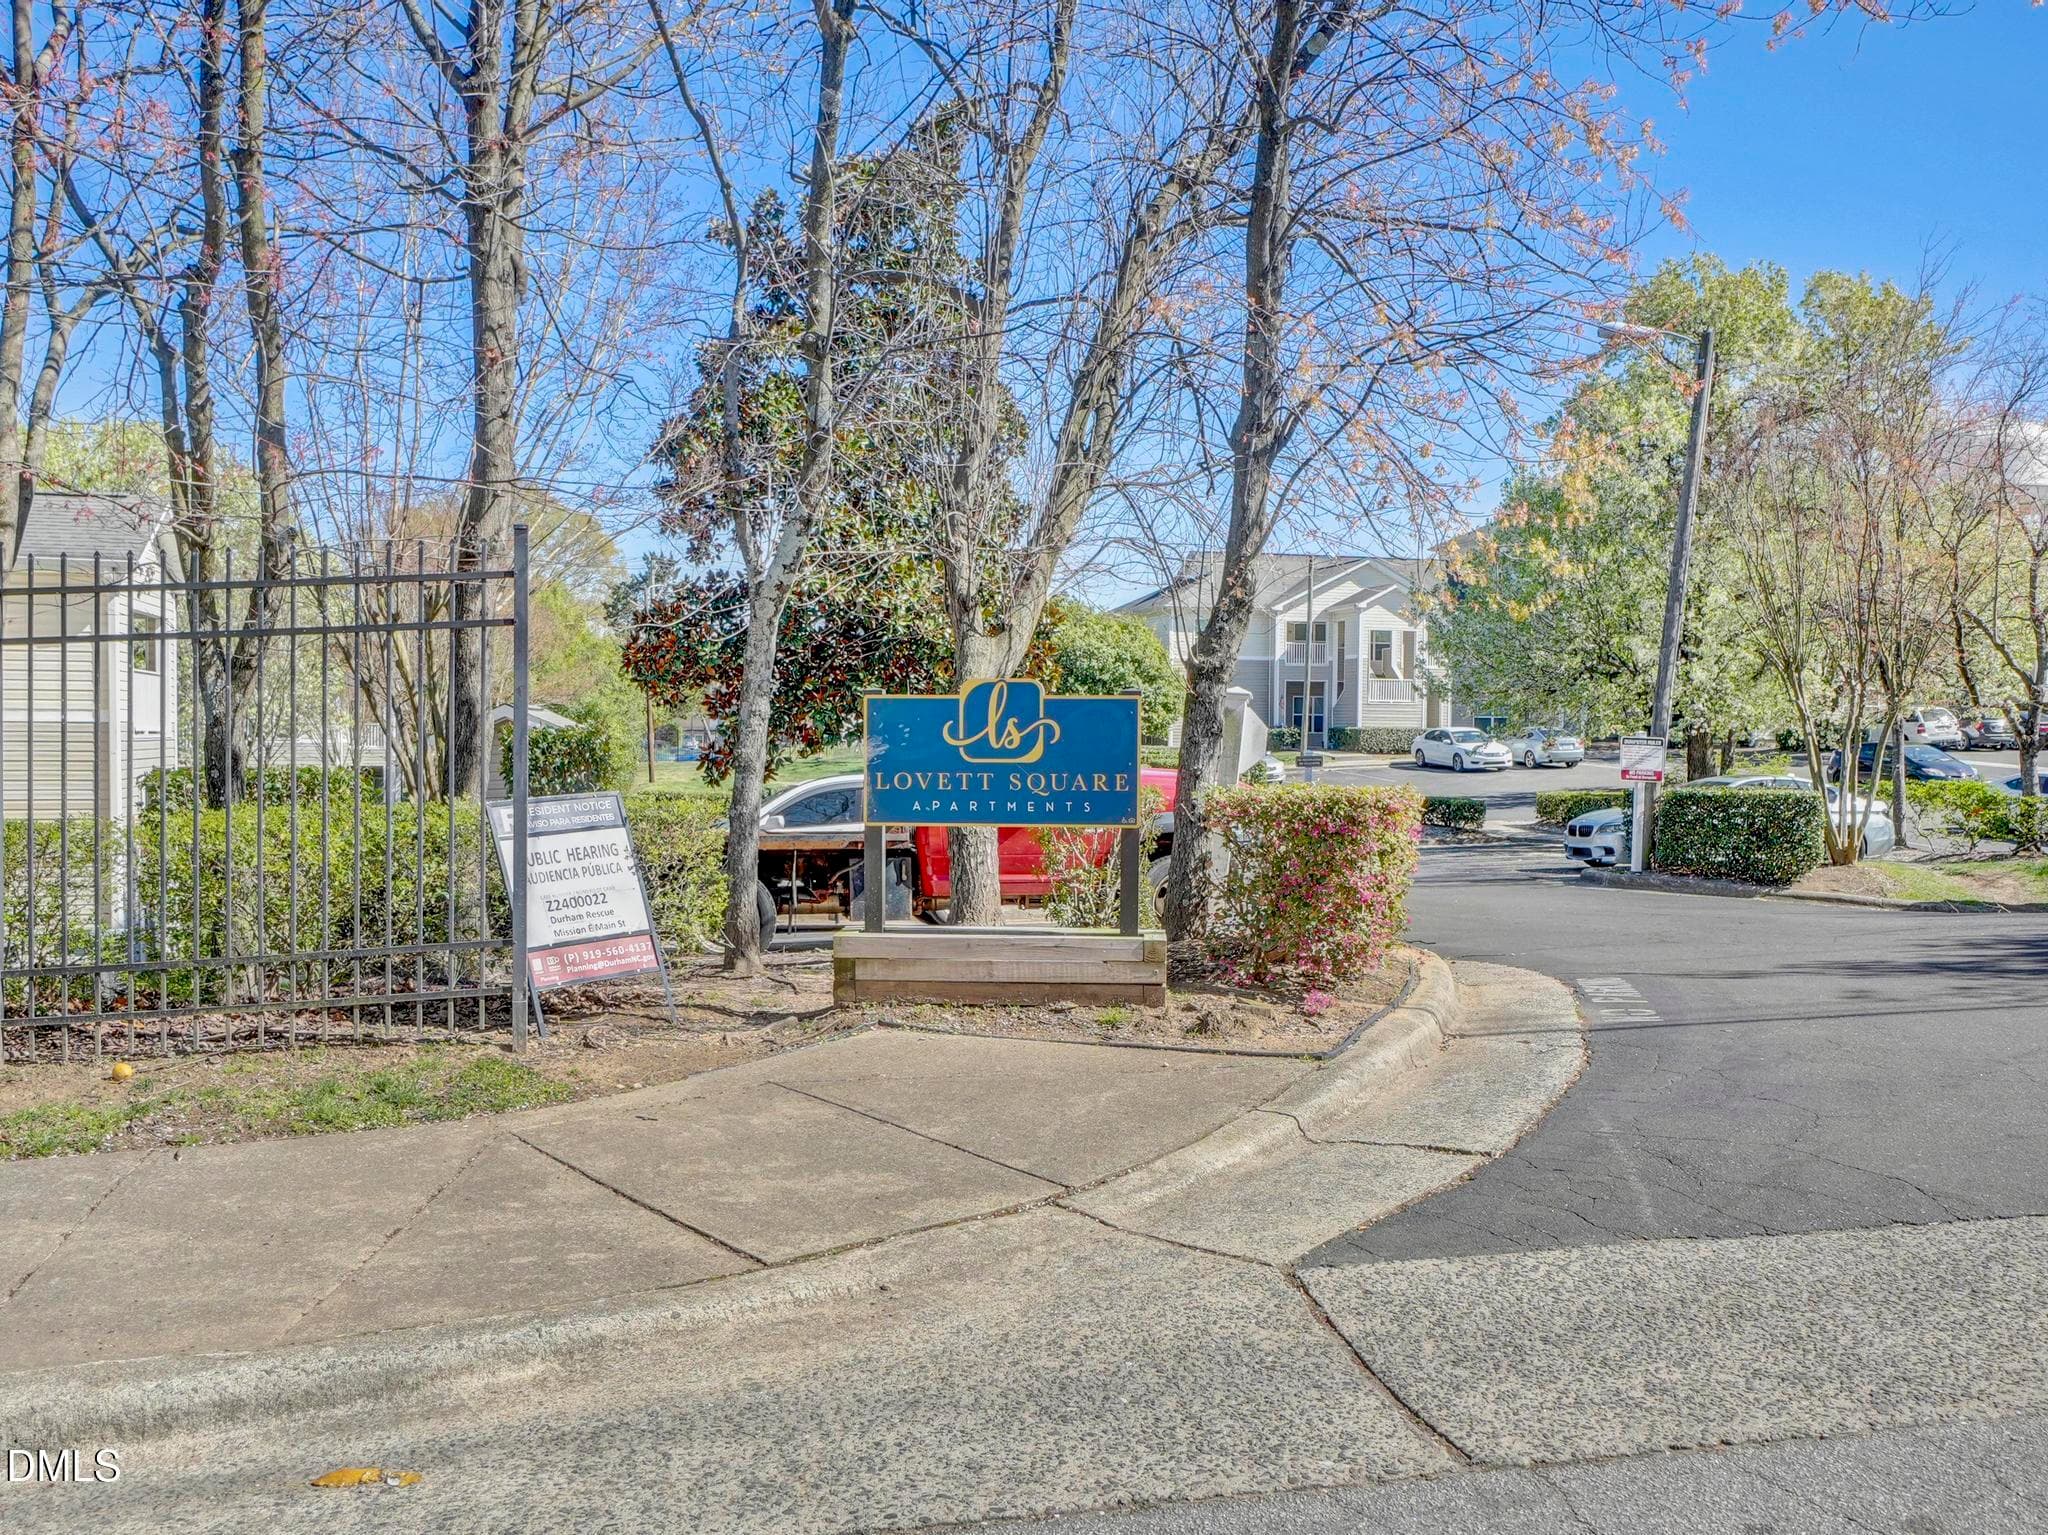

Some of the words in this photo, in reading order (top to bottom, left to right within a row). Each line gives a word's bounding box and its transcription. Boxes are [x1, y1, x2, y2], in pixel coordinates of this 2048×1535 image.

[875, 772, 994, 791] LOVETT
[1009, 773, 1130, 796] SQUARE
[527, 804, 570, 817] ESIDENT
[574, 800, 612, 813] NOTICE
[912, 801, 1092, 812] APARTMENTS
[549, 817, 571, 827] PARA
[571, 812, 615, 825] RESIDENTES
[527, 849, 561, 867] UBLIC
[566, 843, 619, 862] HEARING
[581, 862, 624, 878] PÚBLICA
[550, 913, 585, 925] Durham
[585, 908, 615, 919] Rescue
[553, 926, 587, 937] Mission
[594, 922, 616, 931] Main
[563, 952, 580, 965] (P)
[582, 941, 652, 961] 919-560-4137
